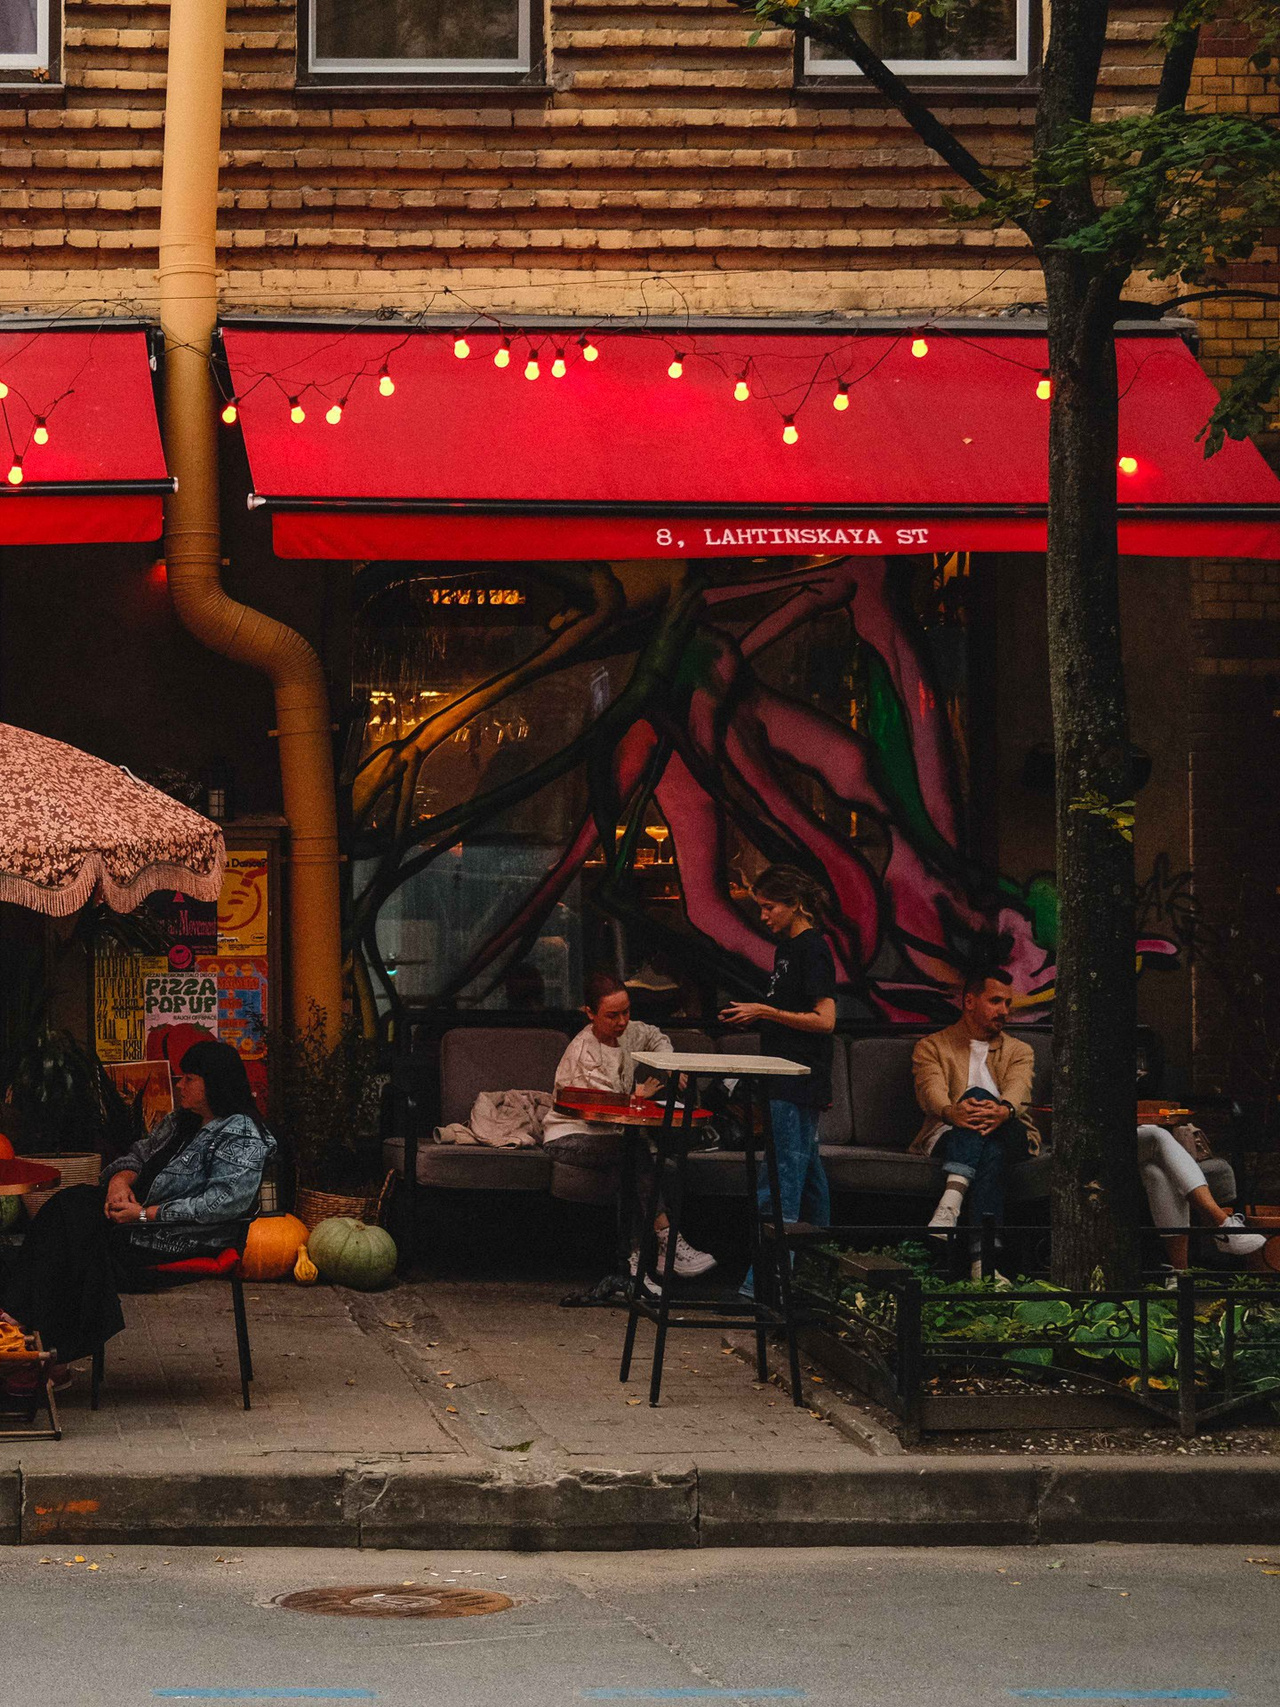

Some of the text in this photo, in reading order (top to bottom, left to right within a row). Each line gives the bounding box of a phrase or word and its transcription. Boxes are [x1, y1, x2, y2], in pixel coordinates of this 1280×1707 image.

[656, 528, 929, 549] 8, LAHTINSKAYA ST
[146, 996, 186, 1013] POP
[189, 996, 217, 1013] UP
